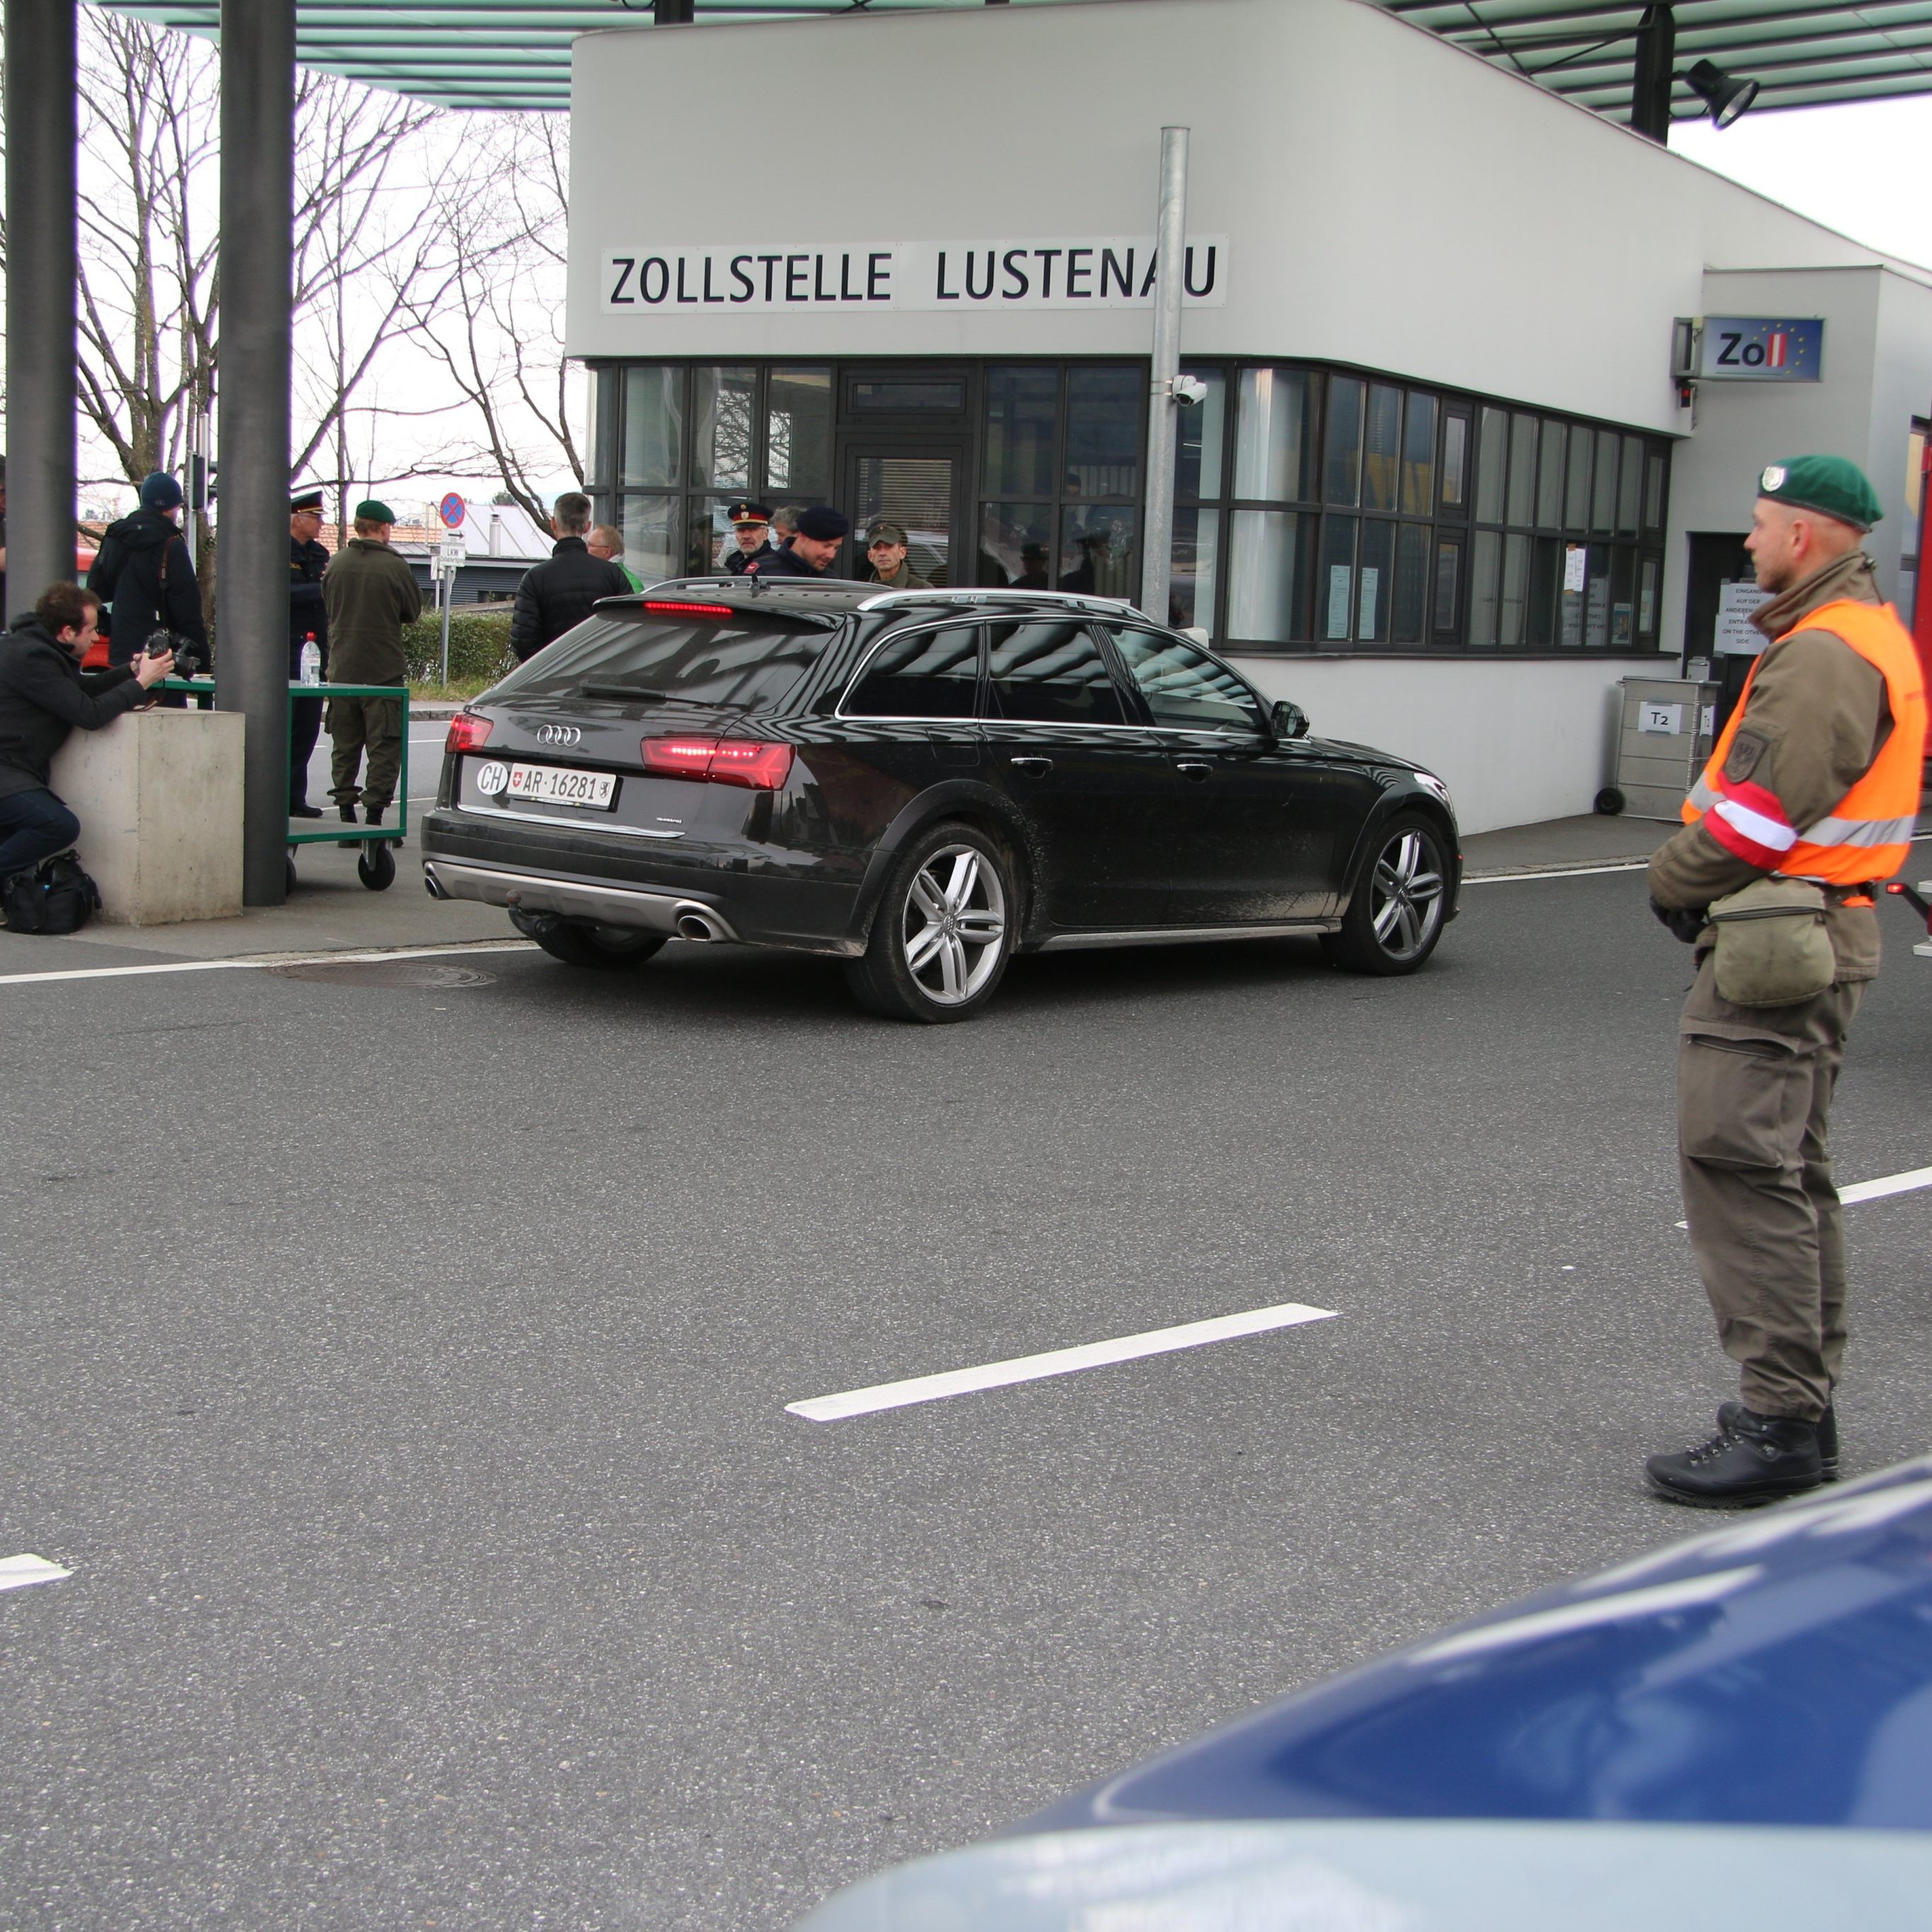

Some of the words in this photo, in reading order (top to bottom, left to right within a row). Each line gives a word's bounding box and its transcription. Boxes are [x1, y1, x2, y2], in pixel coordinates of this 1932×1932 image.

[610, 253, 891, 304] ZOLLSTELLE
[936, 245, 1216, 300] LUSTENAU
[1717, 332, 1787, 366] Zoll
[447, 548, 459, 557] LKW
[1650, 712, 1668, 725] T2
[480, 765, 503, 791] CH
[523, 770, 543, 793] AR
[550, 773, 596, 799] 16281
